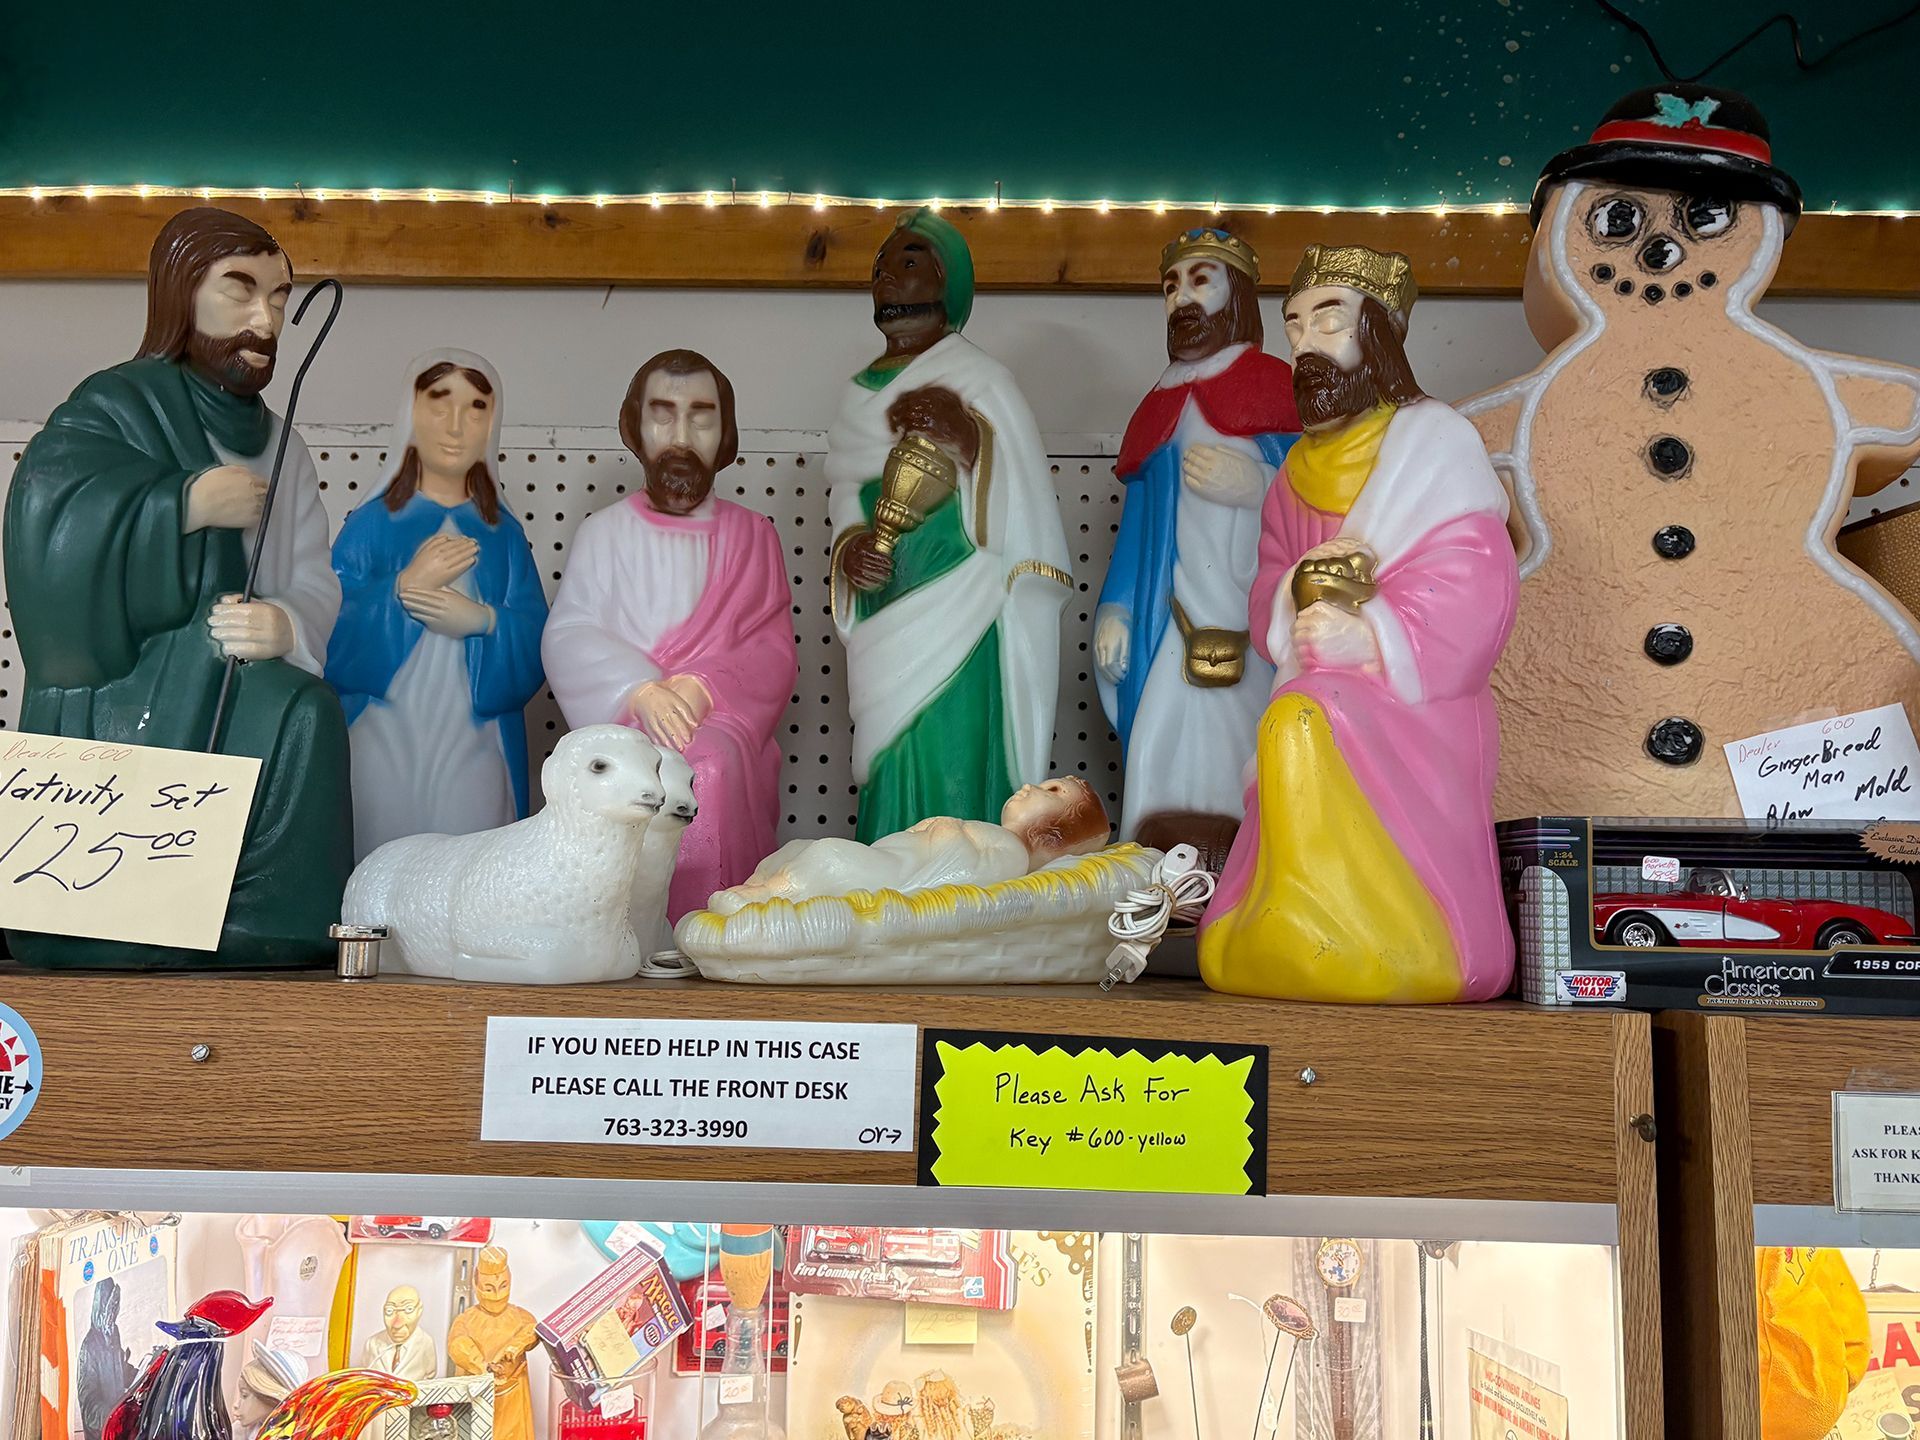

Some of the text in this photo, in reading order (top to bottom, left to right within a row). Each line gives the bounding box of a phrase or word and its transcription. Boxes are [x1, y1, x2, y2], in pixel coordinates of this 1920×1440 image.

[1821, 717, 1855, 735] 600
[3, 739, 134, 762] Dealer 600
[1803, 769, 1845, 790] Man
[1855, 765, 1912, 801] Mold
[150, 782, 230, 810] Set
[1870, 832, 1904, 842] Exclusive
[1548, 858, 1579, 867] SCALE
[1553, 851, 1574, 859] 1:24
[1722, 956, 1815, 980] American
[1853, 959, 1890, 970] 1959
[1571, 976, 1613, 987] MOTOR
[1577, 986, 1605, 997] MAX
[1704, 974, 1782, 998] Classics
[528, 1036, 860, 1060] IF YOU NEED HELP IN THIS CASE
[531, 1076, 849, 1100] PLEASE CALL THE FRONT DESK
[995, 1072, 1190, 1105] Please Ask For
[603, 1117, 748, 1138] 763-323-3990
[1010, 1128, 1052, 1155] Key
[1851, 1148, 1878, 1159] ASK
[1881, 1148, 1907, 1160] FOR
[107, 1240, 139, 1273] ONE
[793, 1262, 816, 1277] Fire
[816, 1263, 860, 1280] Combat
